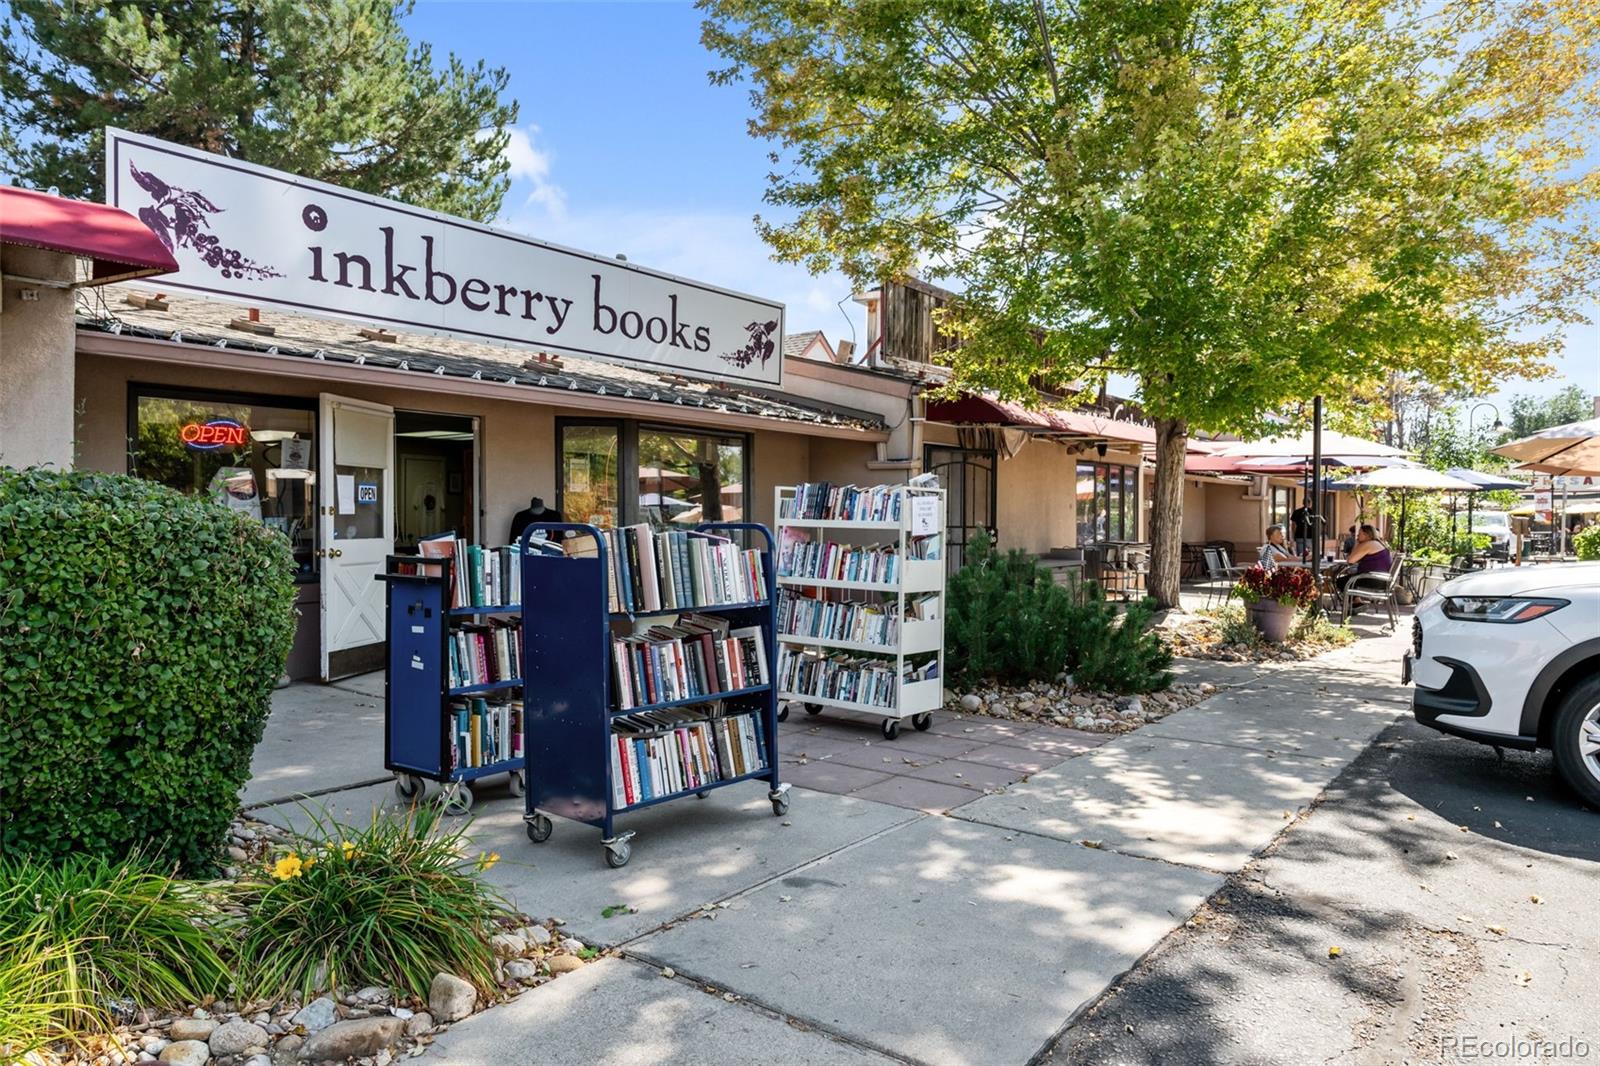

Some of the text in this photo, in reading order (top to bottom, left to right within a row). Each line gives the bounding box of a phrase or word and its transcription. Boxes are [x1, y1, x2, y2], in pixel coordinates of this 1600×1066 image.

[302, 203, 711, 353] inkberry books
[182, 424, 245, 444] OPEN
[360, 487, 376, 500] OPEN
